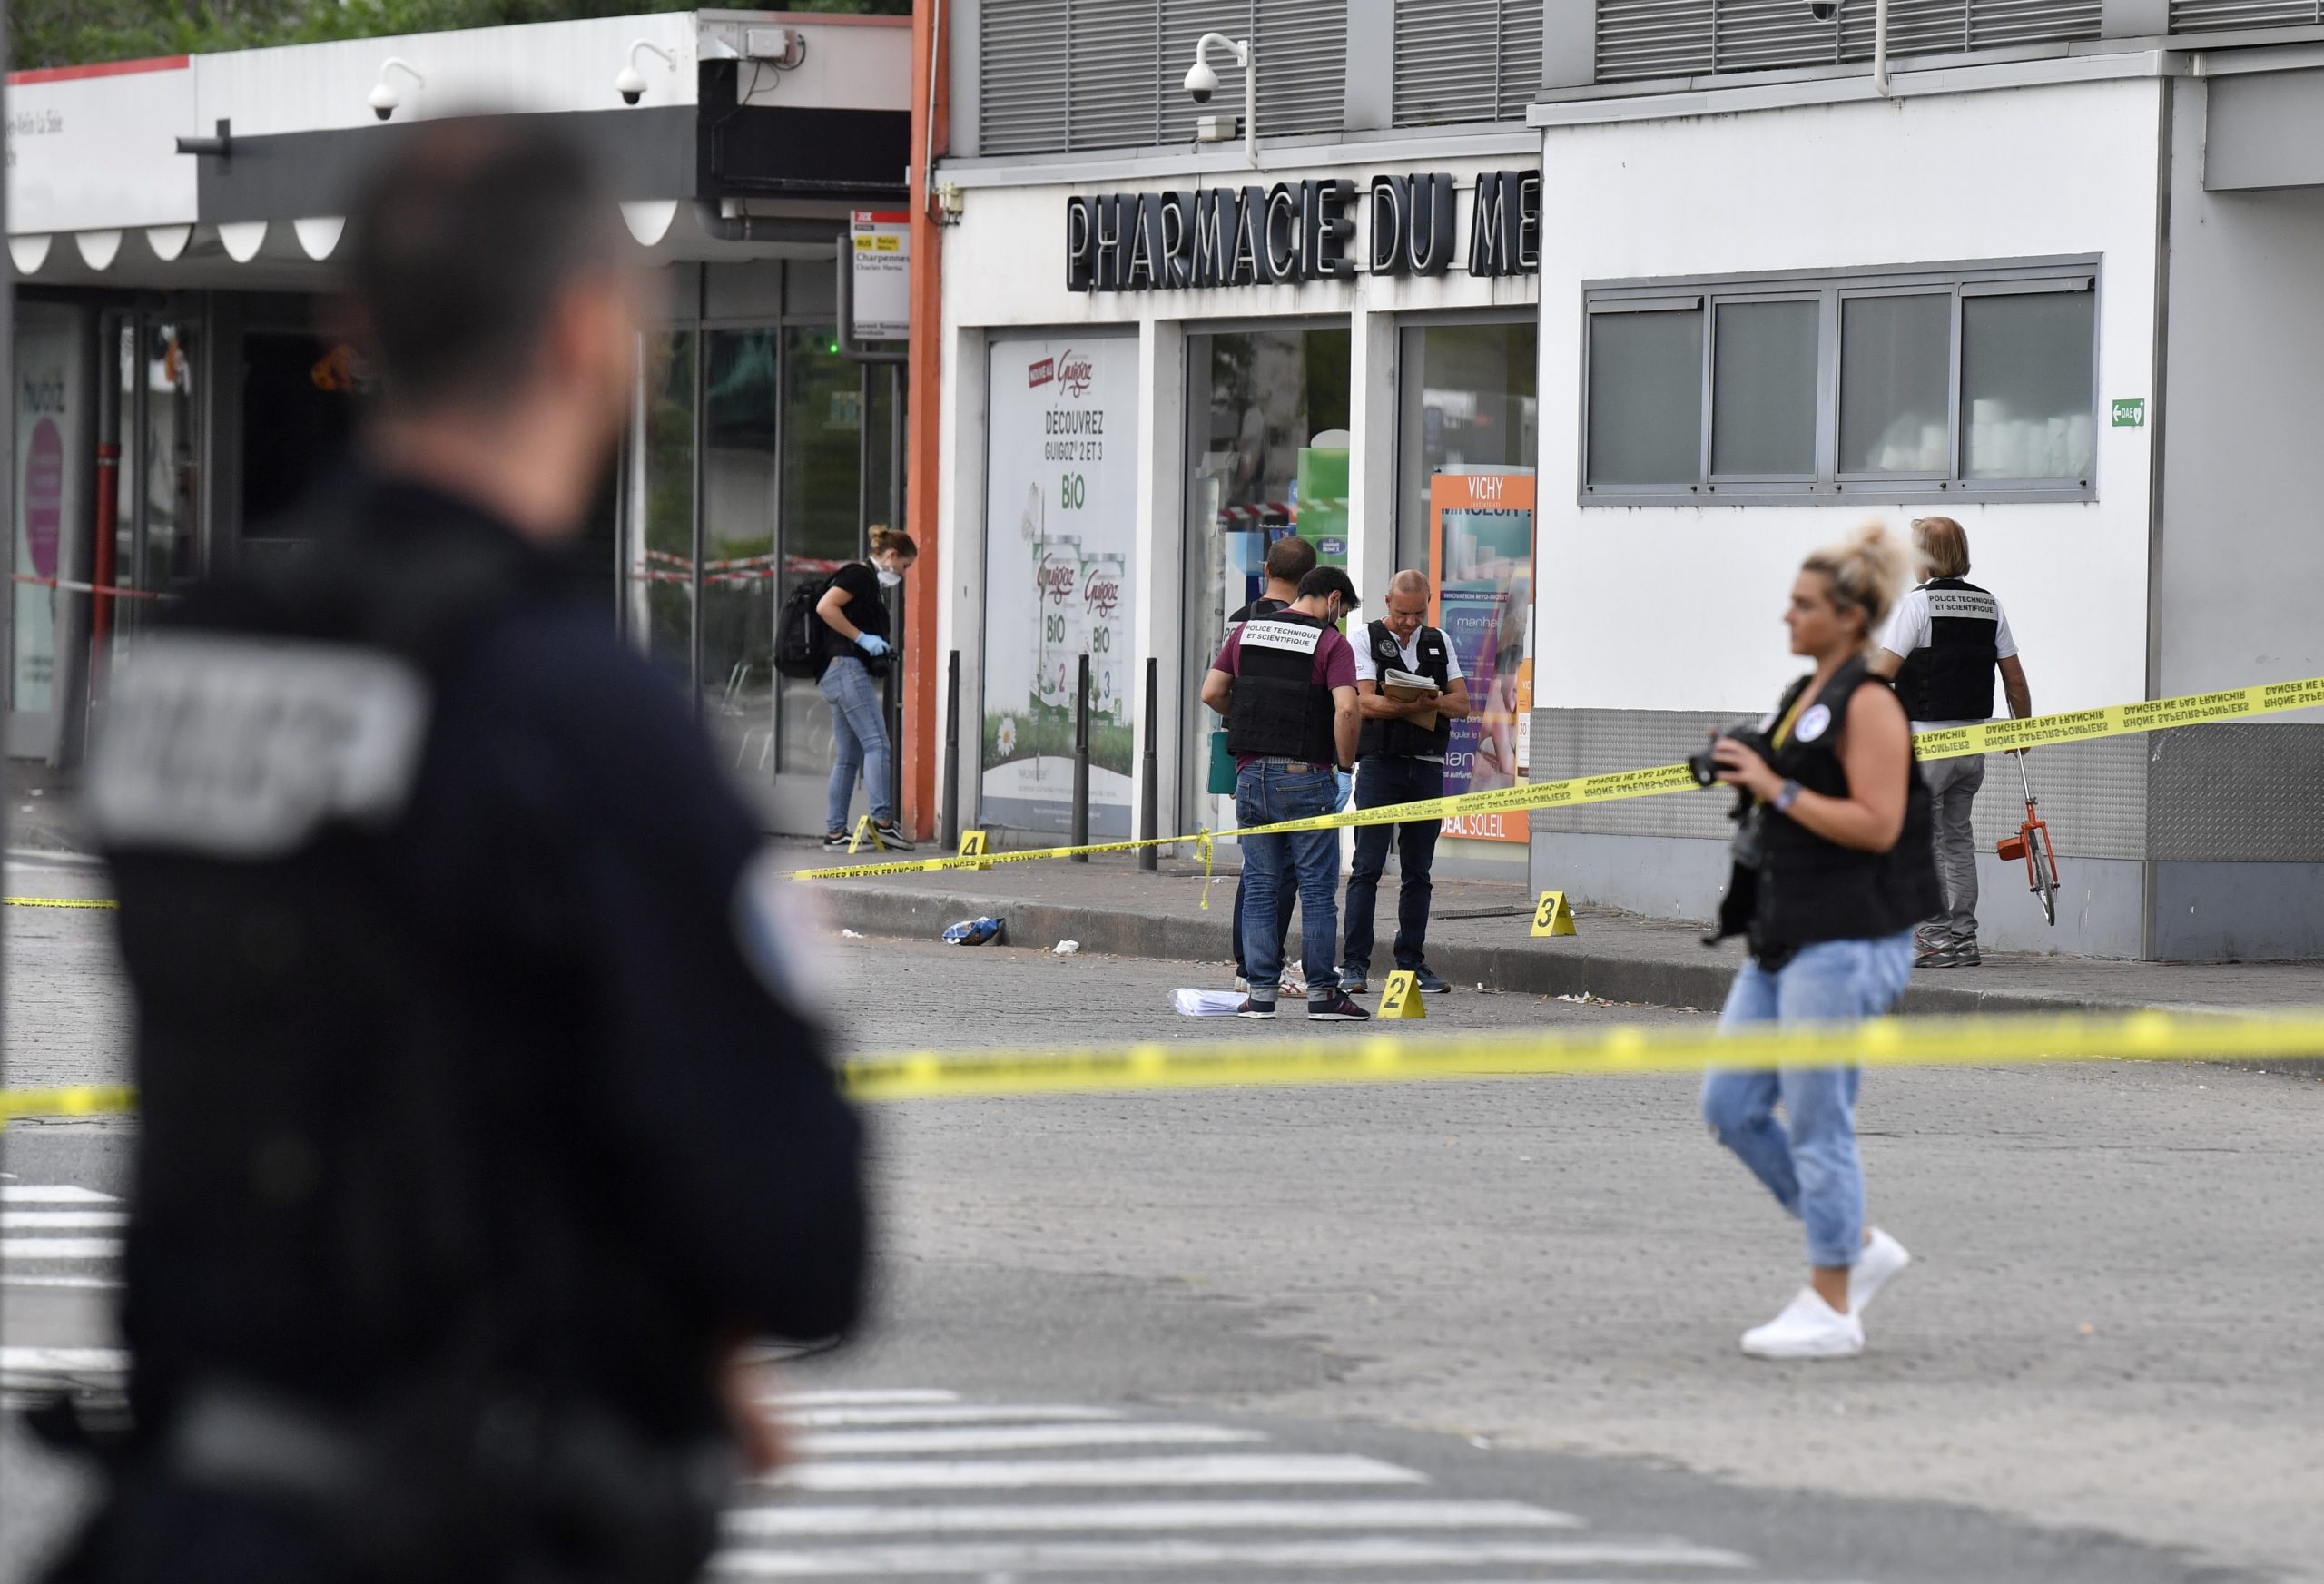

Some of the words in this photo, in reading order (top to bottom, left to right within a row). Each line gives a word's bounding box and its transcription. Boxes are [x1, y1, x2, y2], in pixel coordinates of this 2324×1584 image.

[1068, 178, 1355, 291] PHARMACIE
[1370, 173, 1454, 277] DU
[1469, 170, 1540, 278] ME
[856, 252, 910, 263] Charpennes
[1057, 349, 1093, 398] Guigoz
[1046, 403, 1104, 435] DÉCOUVREZ
[2121, 407, 2134, 418] DAE
[1079, 441, 1085, 461] 2
[1087, 441, 1097, 461] ET
[1098, 441, 1103, 461] 3
[1467, 477, 1504, 500] VICHY
[1084, 568, 1119, 618] Guigoz
[1957, 595, 1997, 605] TECHNIQUE
[1946, 604, 1994, 614] SCIENTIFIQUE
[1245, 625, 1271, 633] POLICE
[1274, 627, 1318, 640] TECHNIQUE
[1257, 634, 1310, 647] SCIENTIFIQUE
[1059, 663, 1066, 693] 2
[1104, 670, 1110, 699] 3
[1469, 813, 1505, 838] SOLEIL
[962, 837, 978, 856] 4
[1538, 898, 1555, 928] 3
[1384, 977, 1406, 1008] 2
